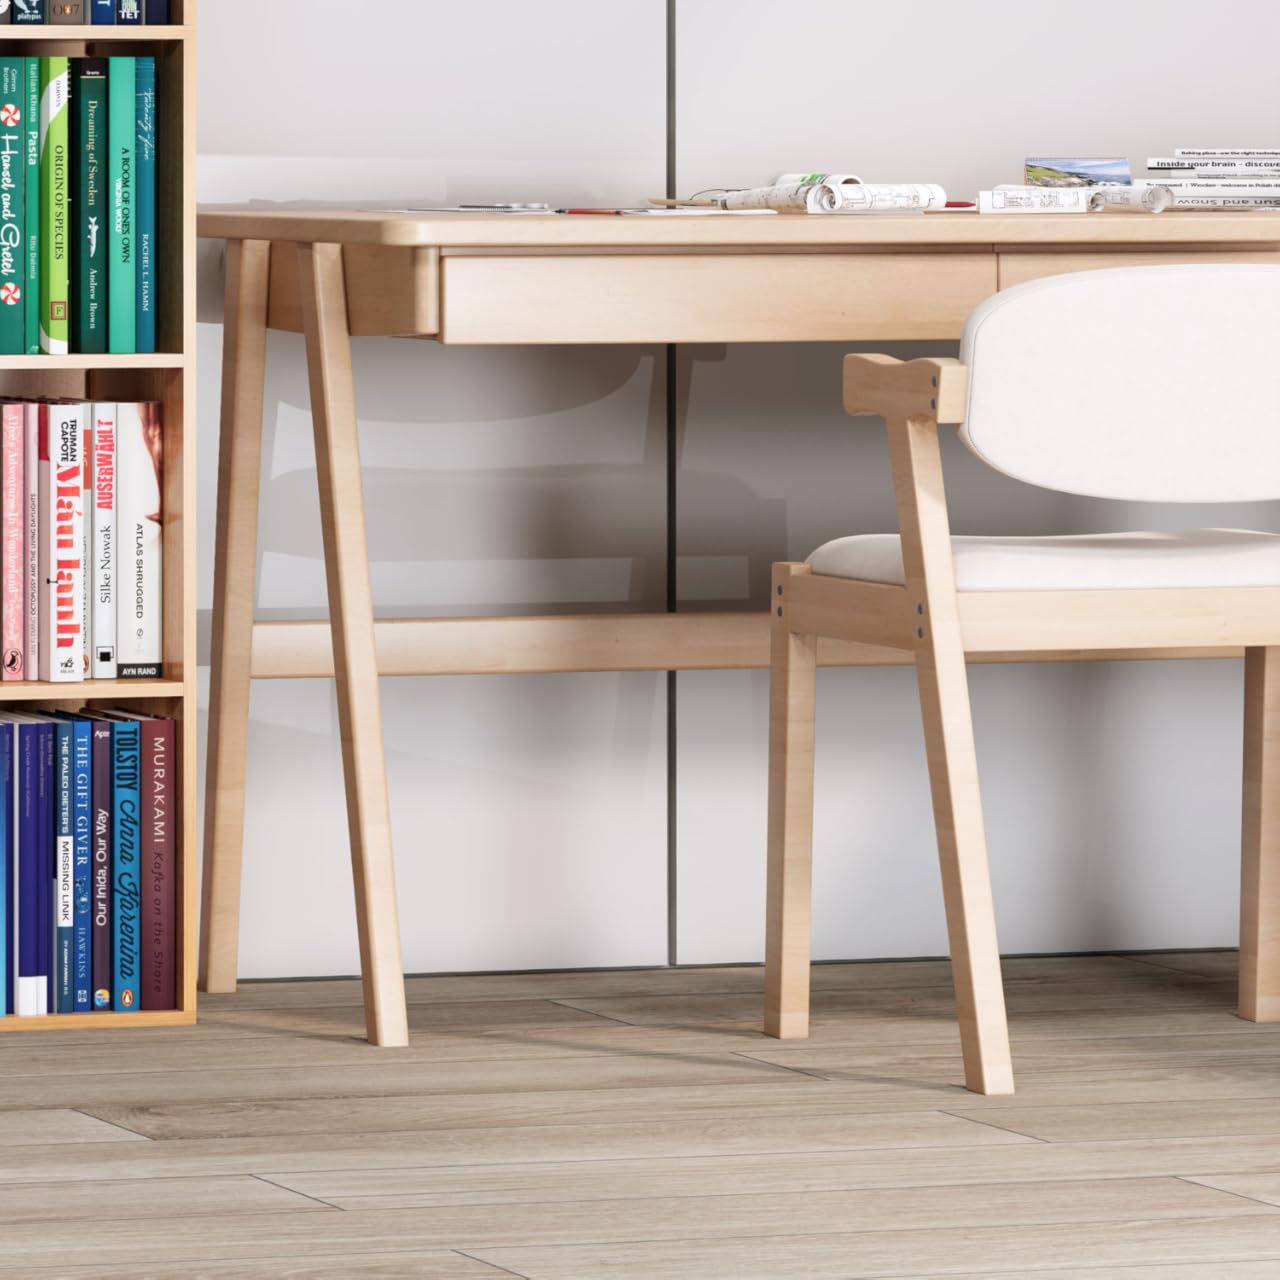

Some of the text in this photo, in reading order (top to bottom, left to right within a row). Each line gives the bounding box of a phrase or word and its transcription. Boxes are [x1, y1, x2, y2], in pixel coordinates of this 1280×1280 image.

[28, 131, 38, 165] Pasta
[87, 100, 98, 205] Dreaming of Sweden
[0, 134, 20, 275] Hansel and Gretel
[55, 145, 63, 259] ORIGIN OF SPECIES
[90, 268, 98, 300] Andrew
[61, 422, 69, 461] CAPOTE
[101, 525, 111, 603] Silke Nowak
[77, 736, 88, 865] THE GIFT GIVER
[116, 728, 138, 790] TOLSTOY
[153, 737, 165, 843] MURAKAMI
[114, 800, 139, 980] Anna Karenina
[152, 852, 164, 992] Kafka on the Shore
[78, 928, 86, 978] HAWKINS
